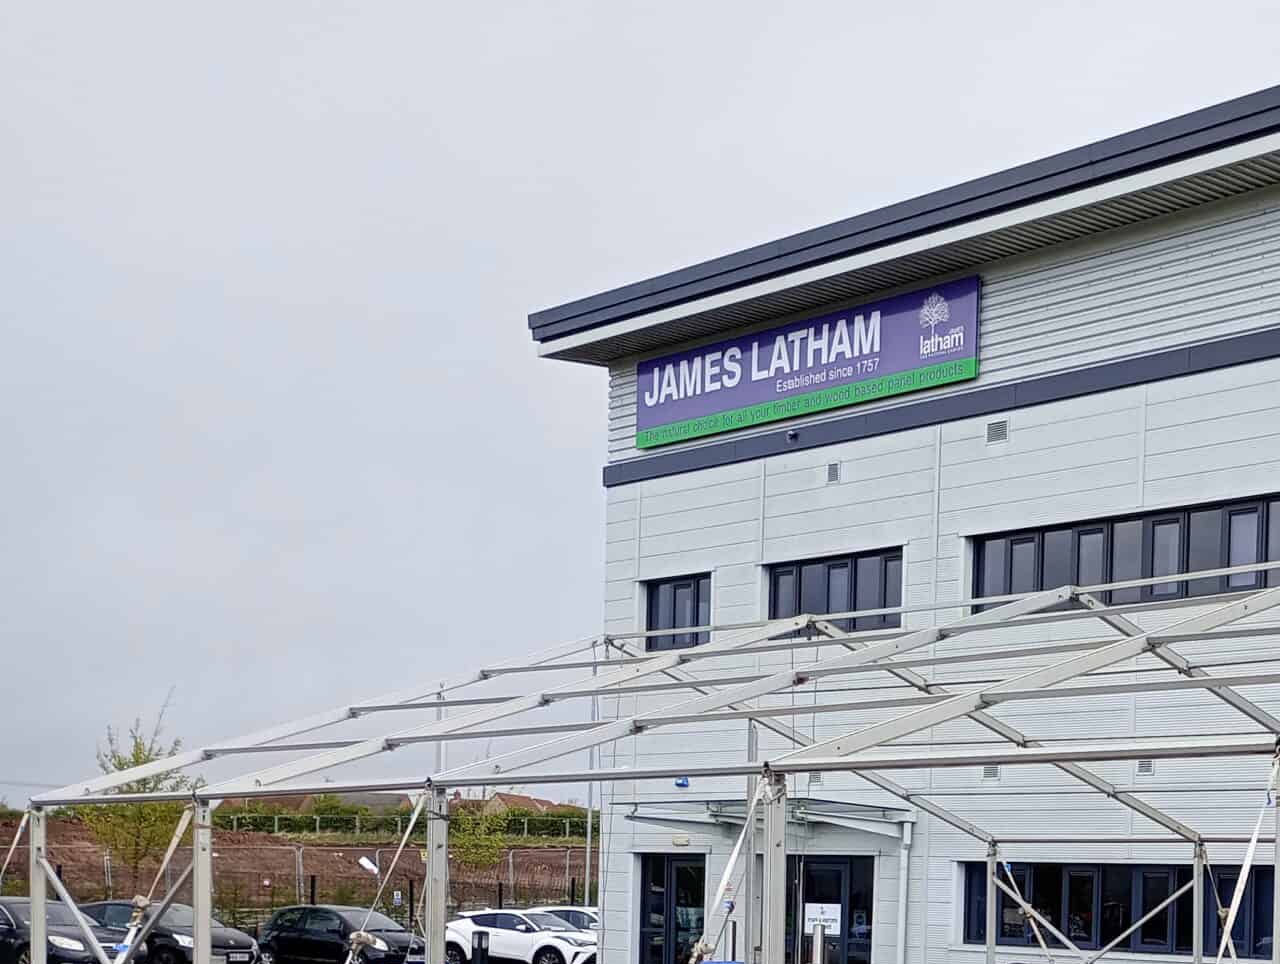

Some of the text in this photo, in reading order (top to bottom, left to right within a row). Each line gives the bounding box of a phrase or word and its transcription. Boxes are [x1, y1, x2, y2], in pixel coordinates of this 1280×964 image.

[644, 311, 881, 407] JAMES LATHAM
[920, 332, 964, 355] latham
[776, 358, 880, 393] Established since 1757
[722, 413, 734, 426] for
[750, 405, 771, 421] your
[773, 400, 800, 416] timber
[804, 394, 822, 408] and
[824, 389, 850, 403] wood
[854, 380, 884, 398] based
[888, 374, 915, 392] panel
